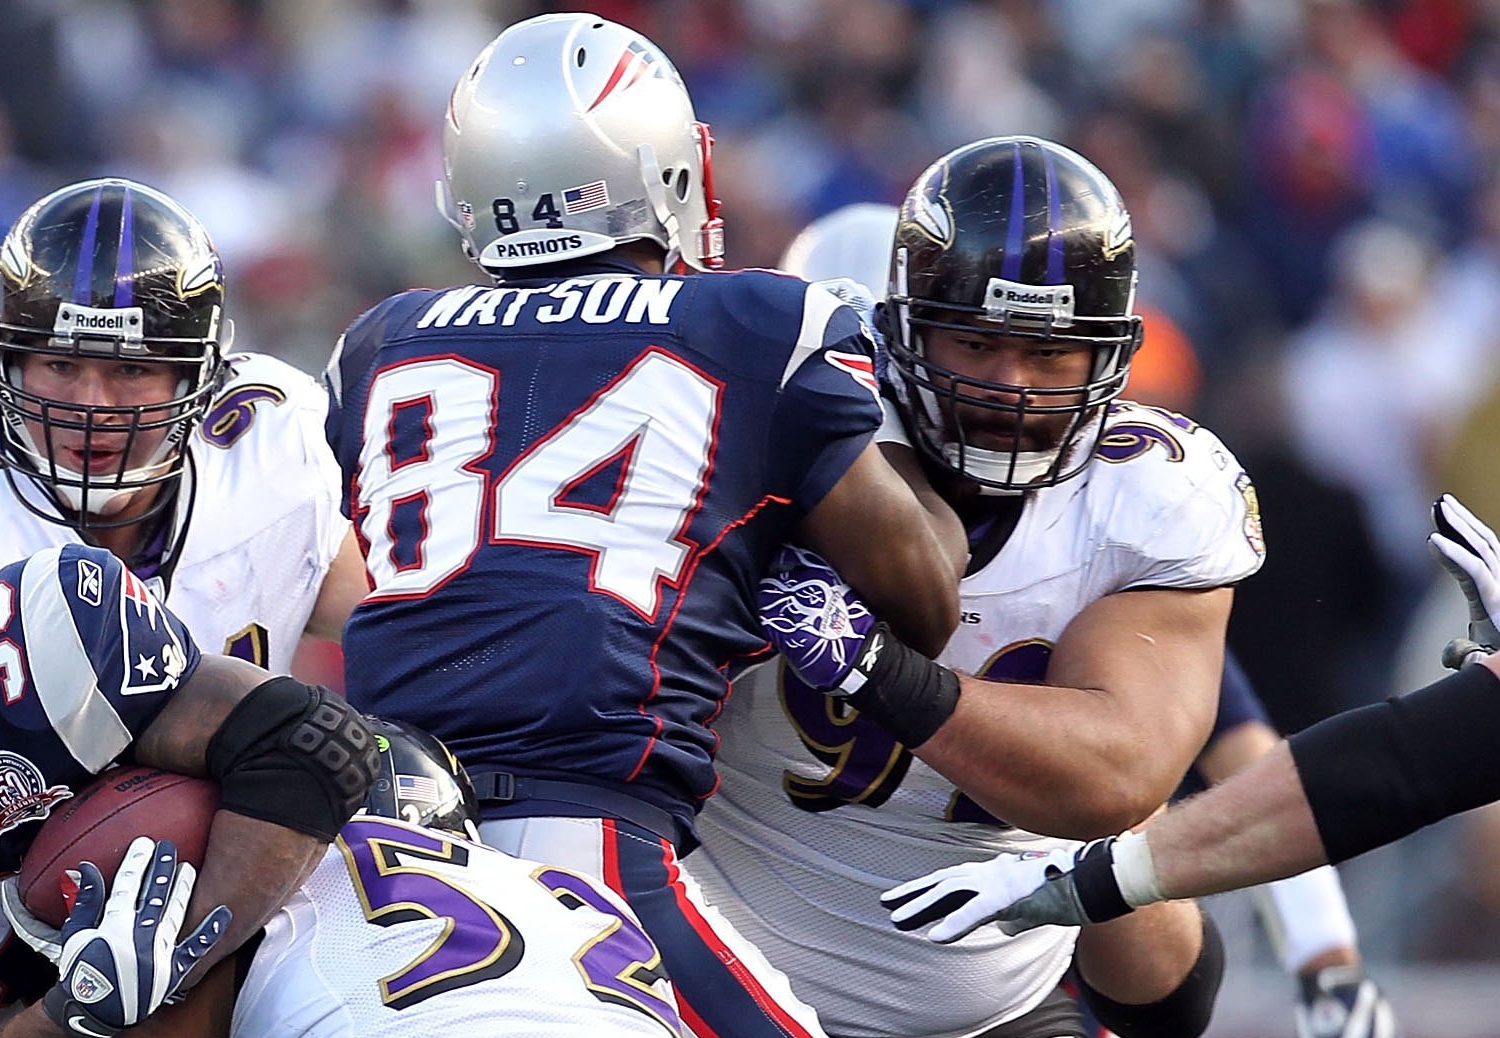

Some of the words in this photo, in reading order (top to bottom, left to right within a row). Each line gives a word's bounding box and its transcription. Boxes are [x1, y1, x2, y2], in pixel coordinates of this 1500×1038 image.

[492, 193, 563, 234] 84
[497, 234, 582, 257] PATRIOTS
[76, 314, 123, 329] Riddell
[417, 277, 684, 329] WATSON
[351, 345, 726, 624] 84
